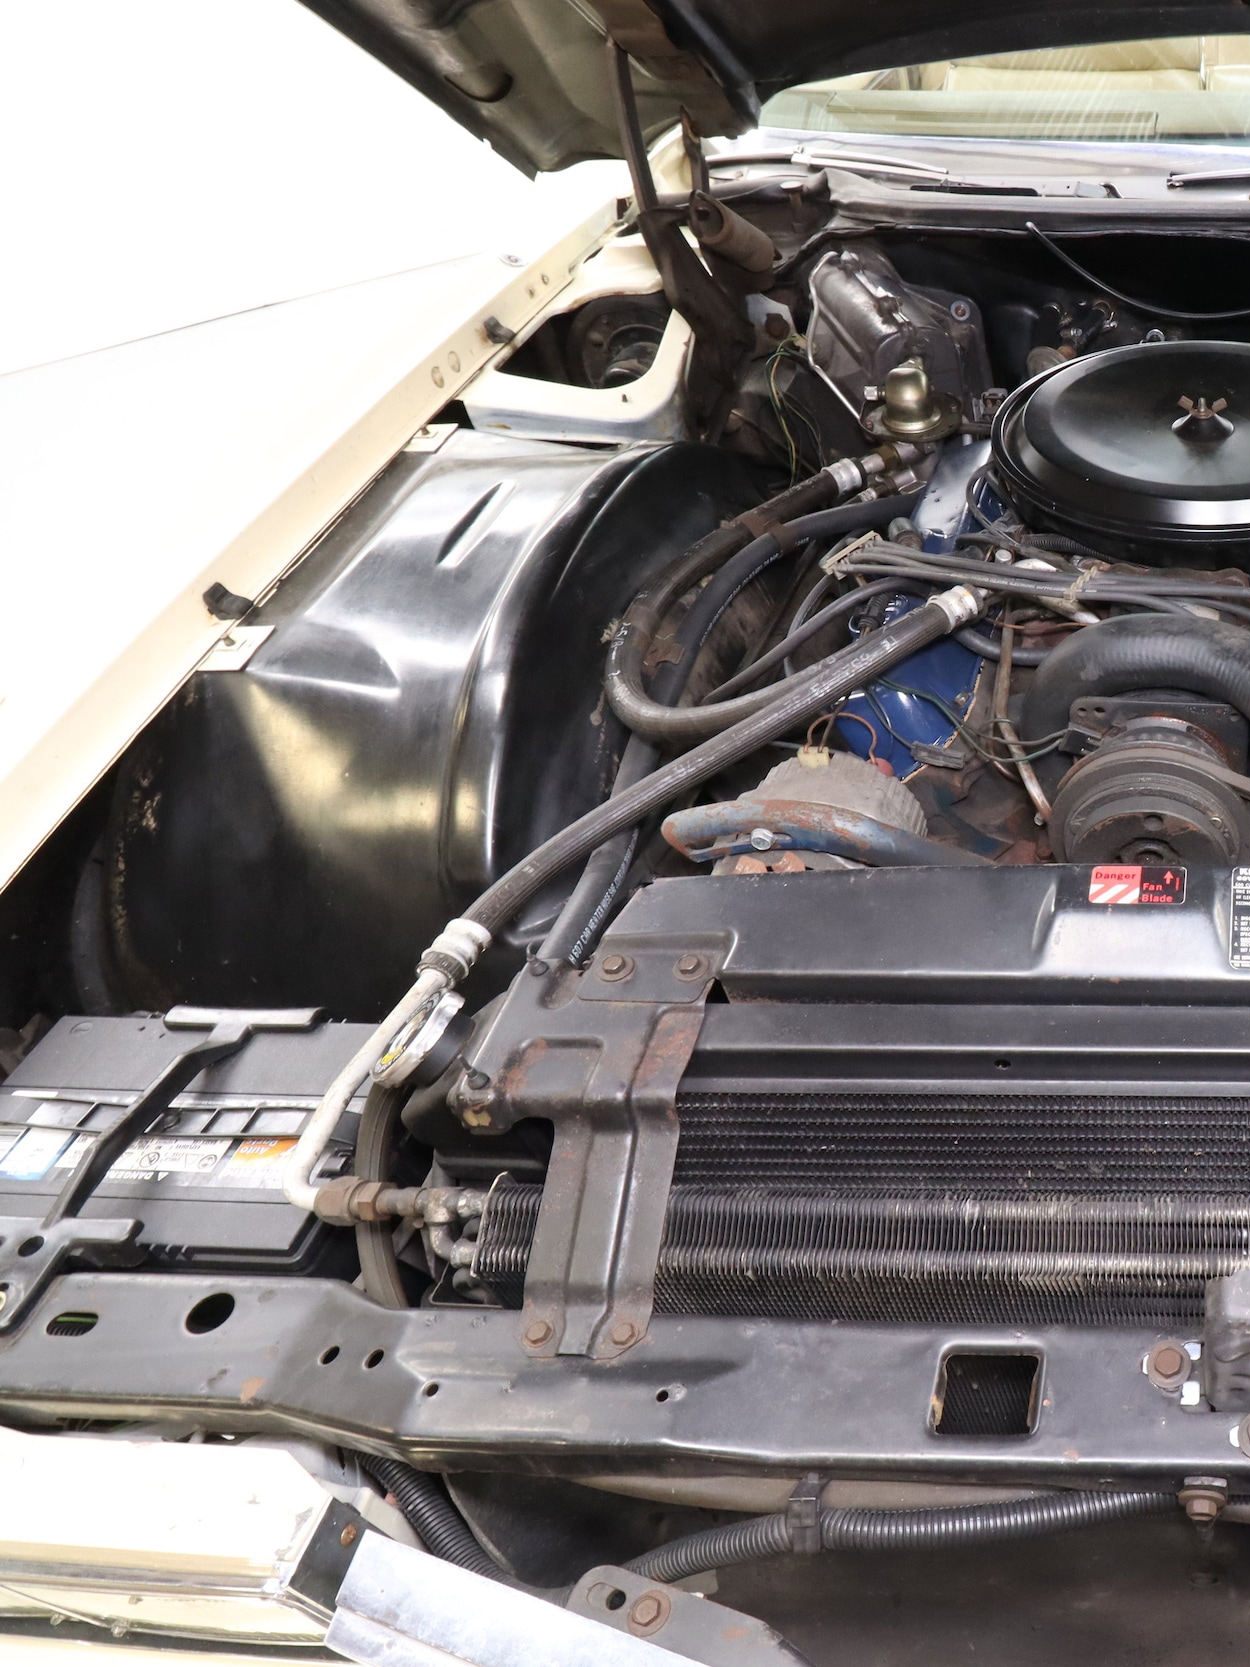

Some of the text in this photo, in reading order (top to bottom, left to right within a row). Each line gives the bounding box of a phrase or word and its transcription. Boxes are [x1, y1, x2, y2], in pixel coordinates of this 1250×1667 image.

[1095, 872, 1137, 881] Danger
[1142, 882, 1163, 891] Fan
[1141, 894, 1173, 903] Blade
[572, 940, 584, 958] 607
[581, 927, 592, 944] CAR
[240, 1146, 270, 1155] Auto
